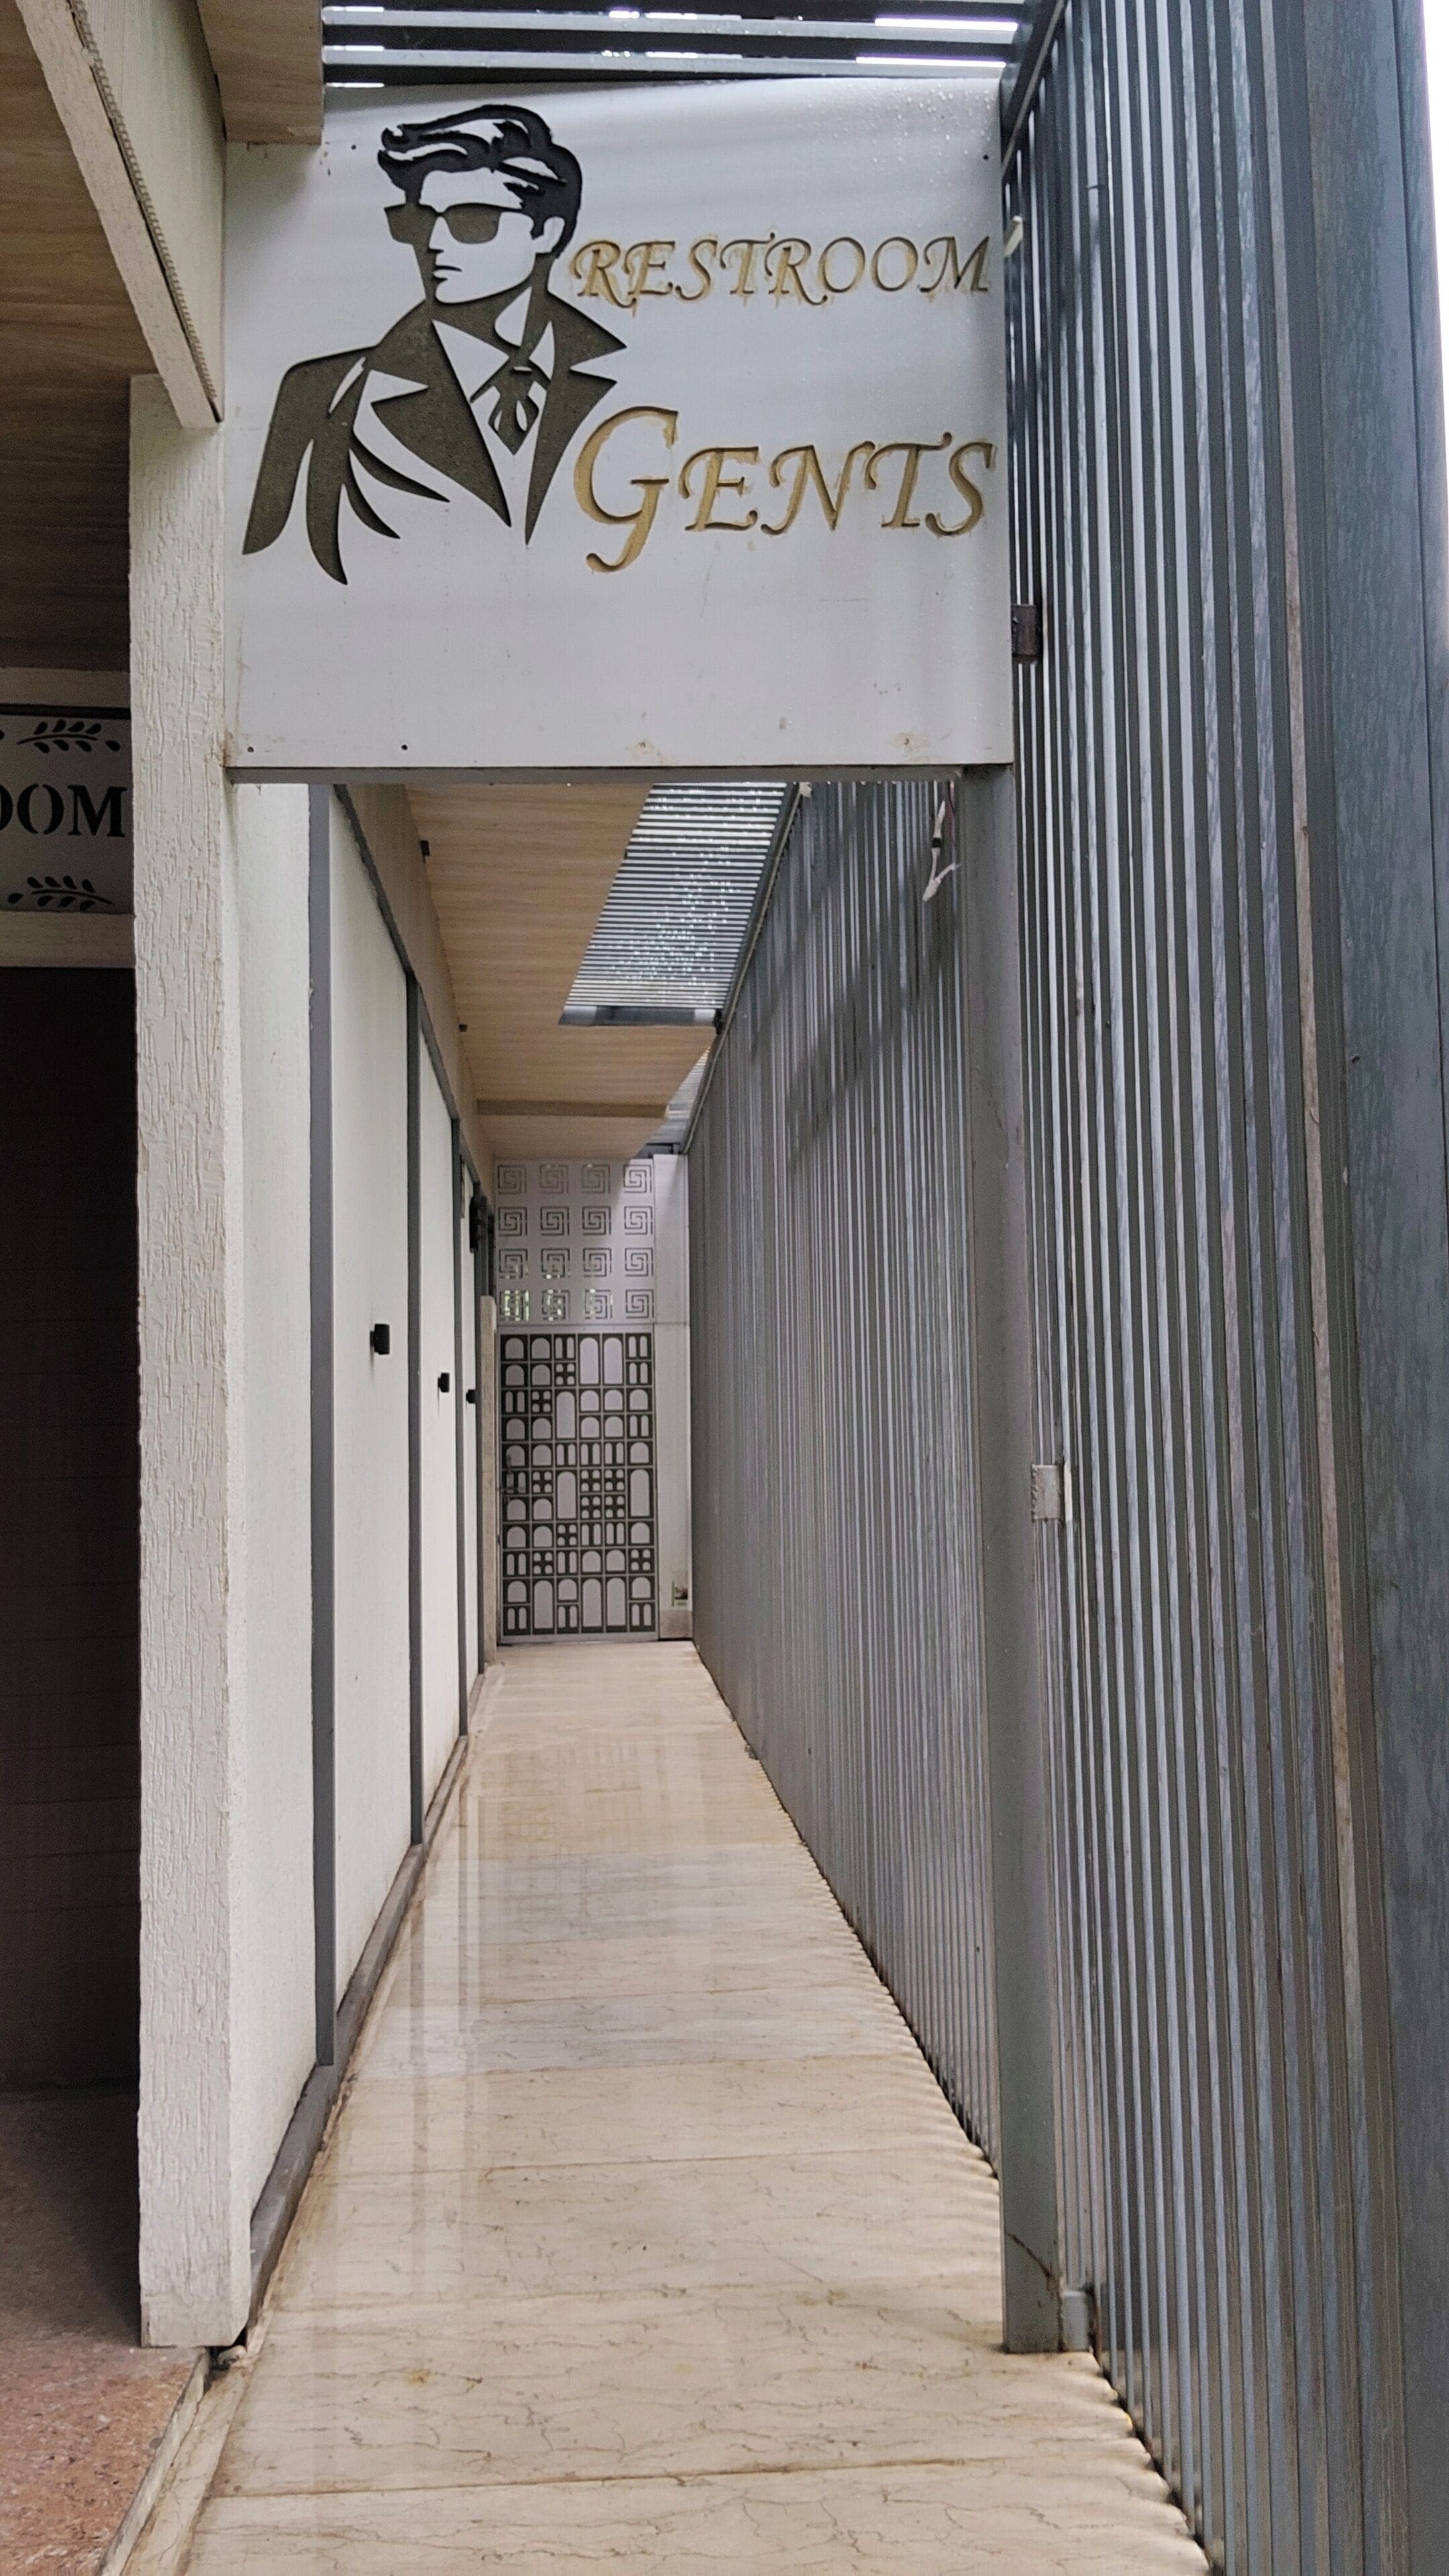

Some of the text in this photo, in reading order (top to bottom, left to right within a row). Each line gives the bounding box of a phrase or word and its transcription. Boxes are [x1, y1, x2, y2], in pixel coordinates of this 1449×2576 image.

[573, 232, 991, 309] RESTROOM
[574, 405, 996, 572] GENTS
[0, 784, 127, 837] OM
